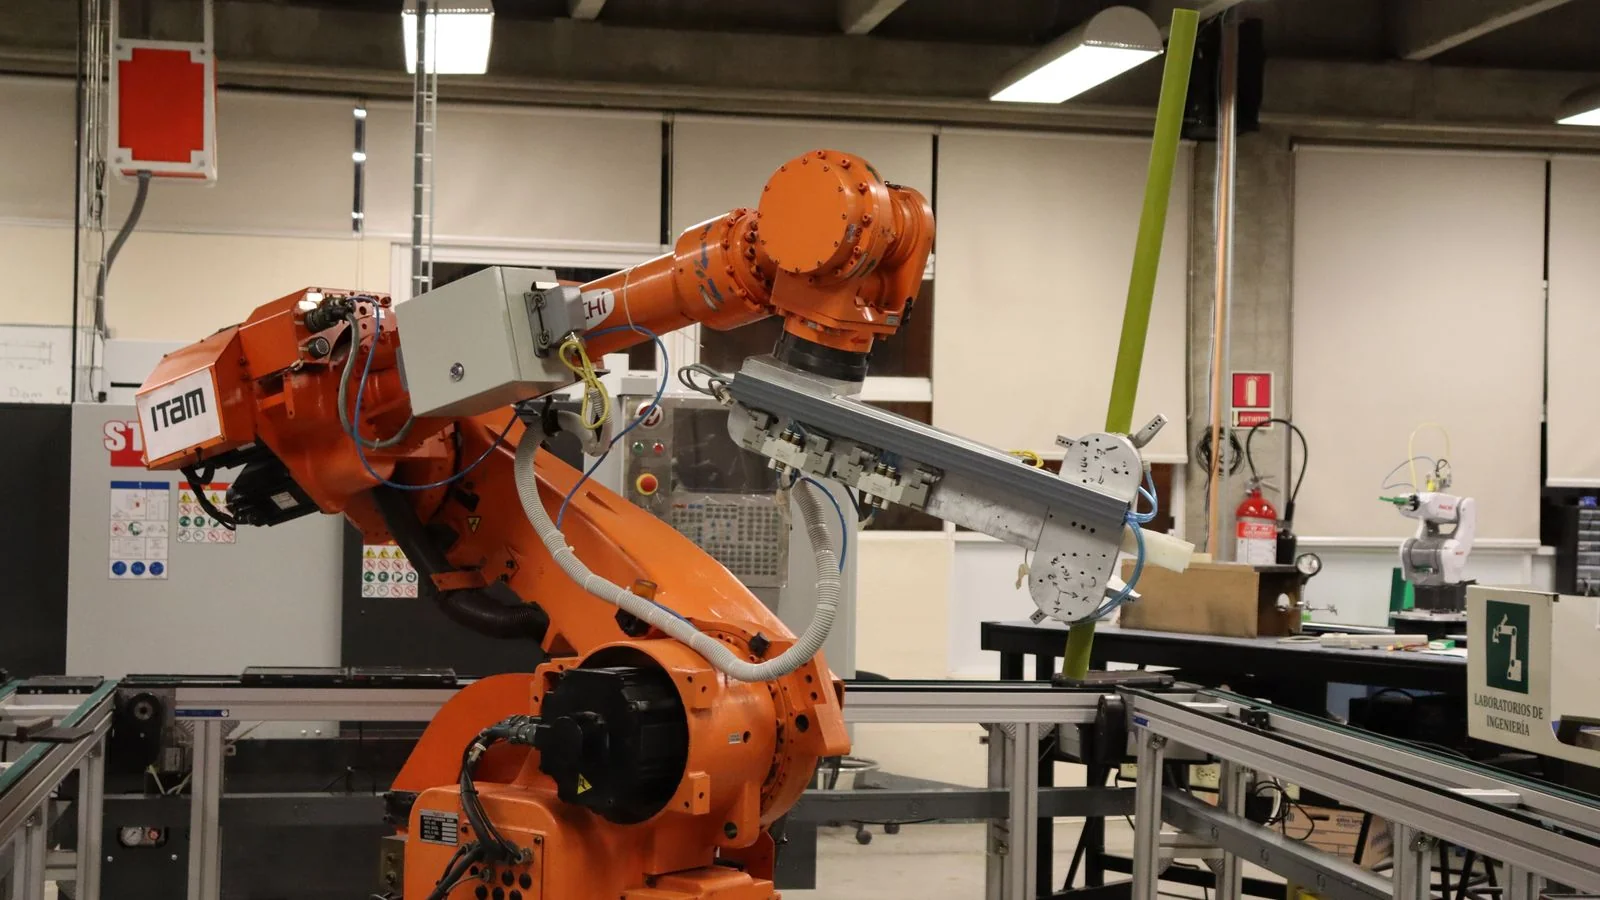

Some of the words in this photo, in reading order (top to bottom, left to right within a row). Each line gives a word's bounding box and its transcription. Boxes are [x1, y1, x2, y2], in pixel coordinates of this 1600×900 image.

[1474, 693, 1531, 716] LABORATORIOS
[1532, 705, 1543, 719] DE
[1486, 714, 1530, 736] INGENIERÍA
